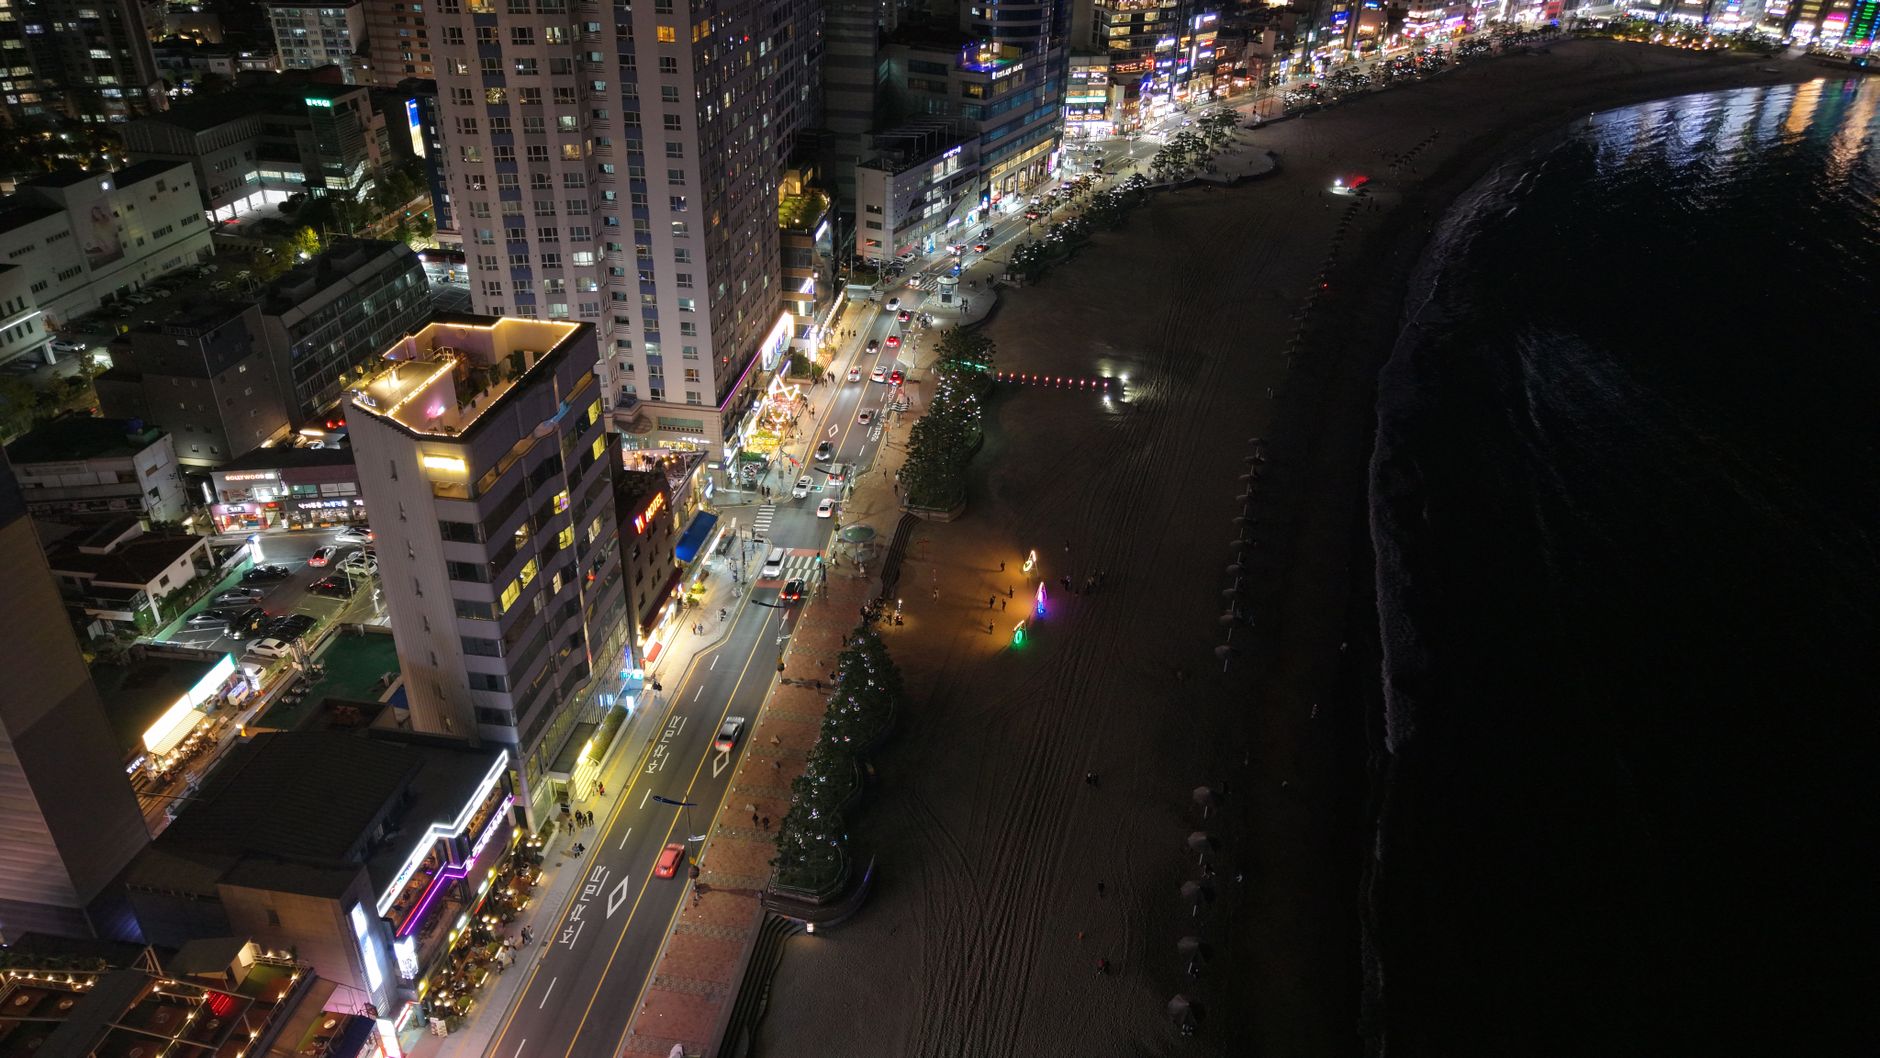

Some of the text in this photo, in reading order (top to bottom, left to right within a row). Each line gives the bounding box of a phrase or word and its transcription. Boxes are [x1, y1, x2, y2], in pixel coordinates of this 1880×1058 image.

[645, 492, 664, 523] HOTEL
[646, 716, 680, 773] 주차금지
[559, 865, 606, 943] 주차금지
